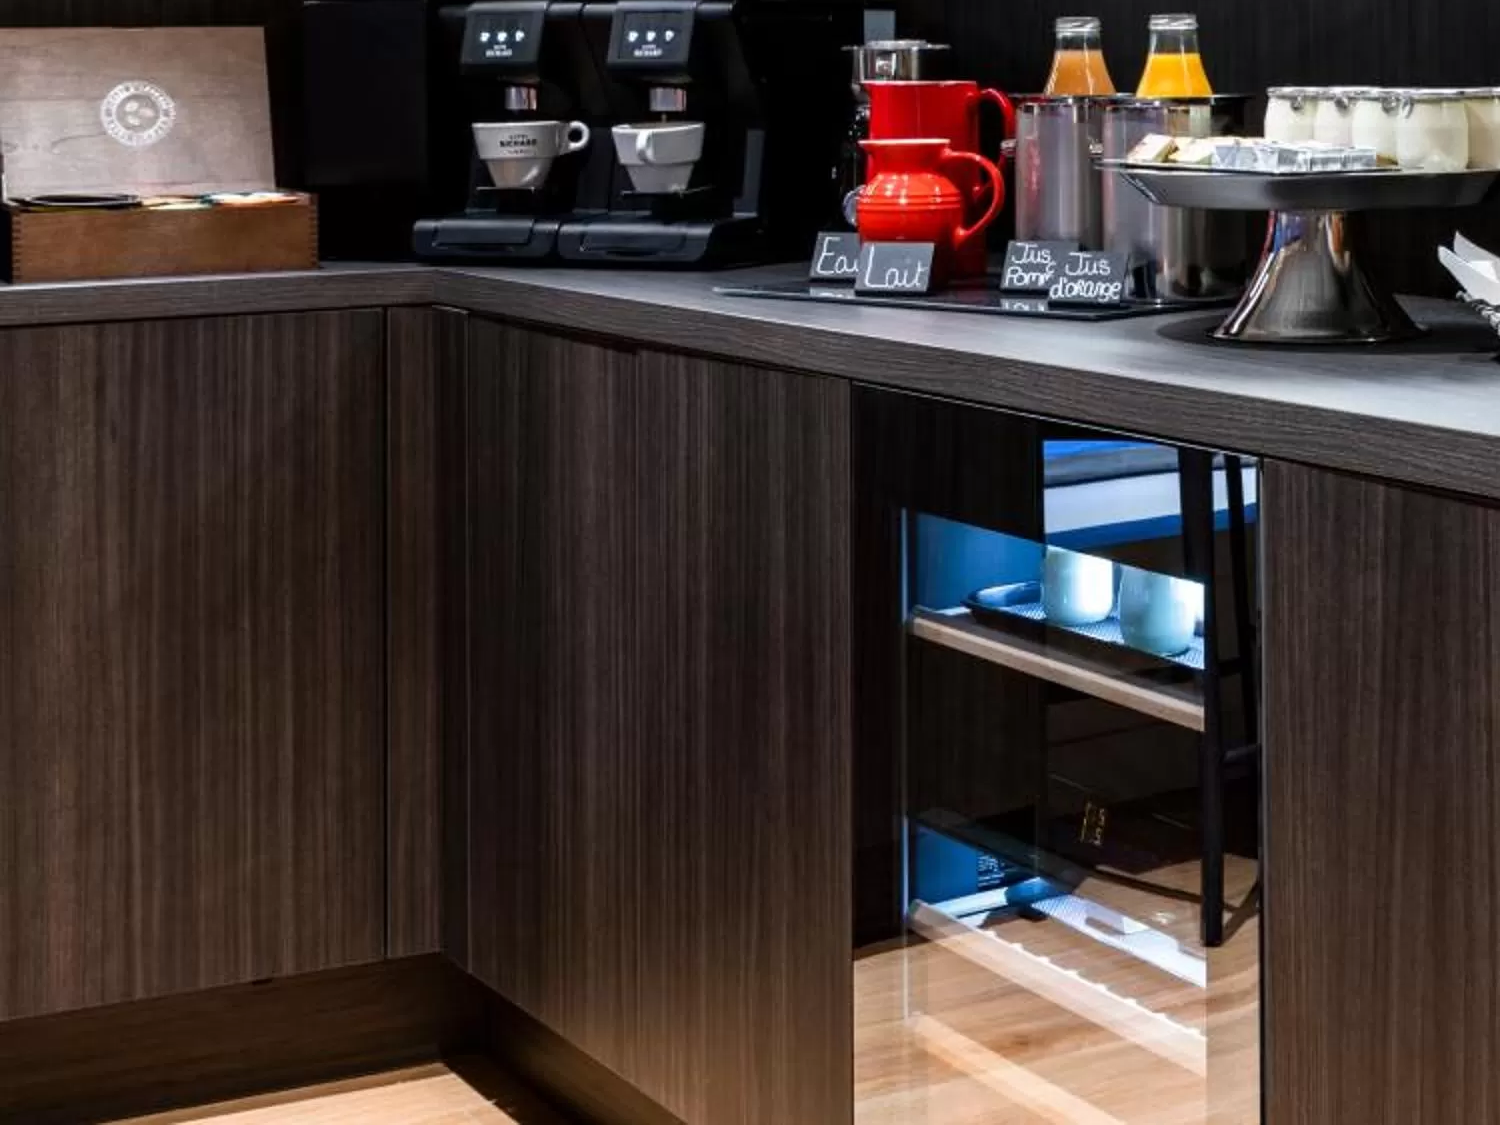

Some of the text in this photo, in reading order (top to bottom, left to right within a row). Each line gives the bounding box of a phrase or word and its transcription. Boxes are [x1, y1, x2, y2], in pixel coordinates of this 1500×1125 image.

[1011, 241, 1052, 264] Jus
[1065, 251, 1111, 276] Jus
[864, 243, 929, 289] Lait
